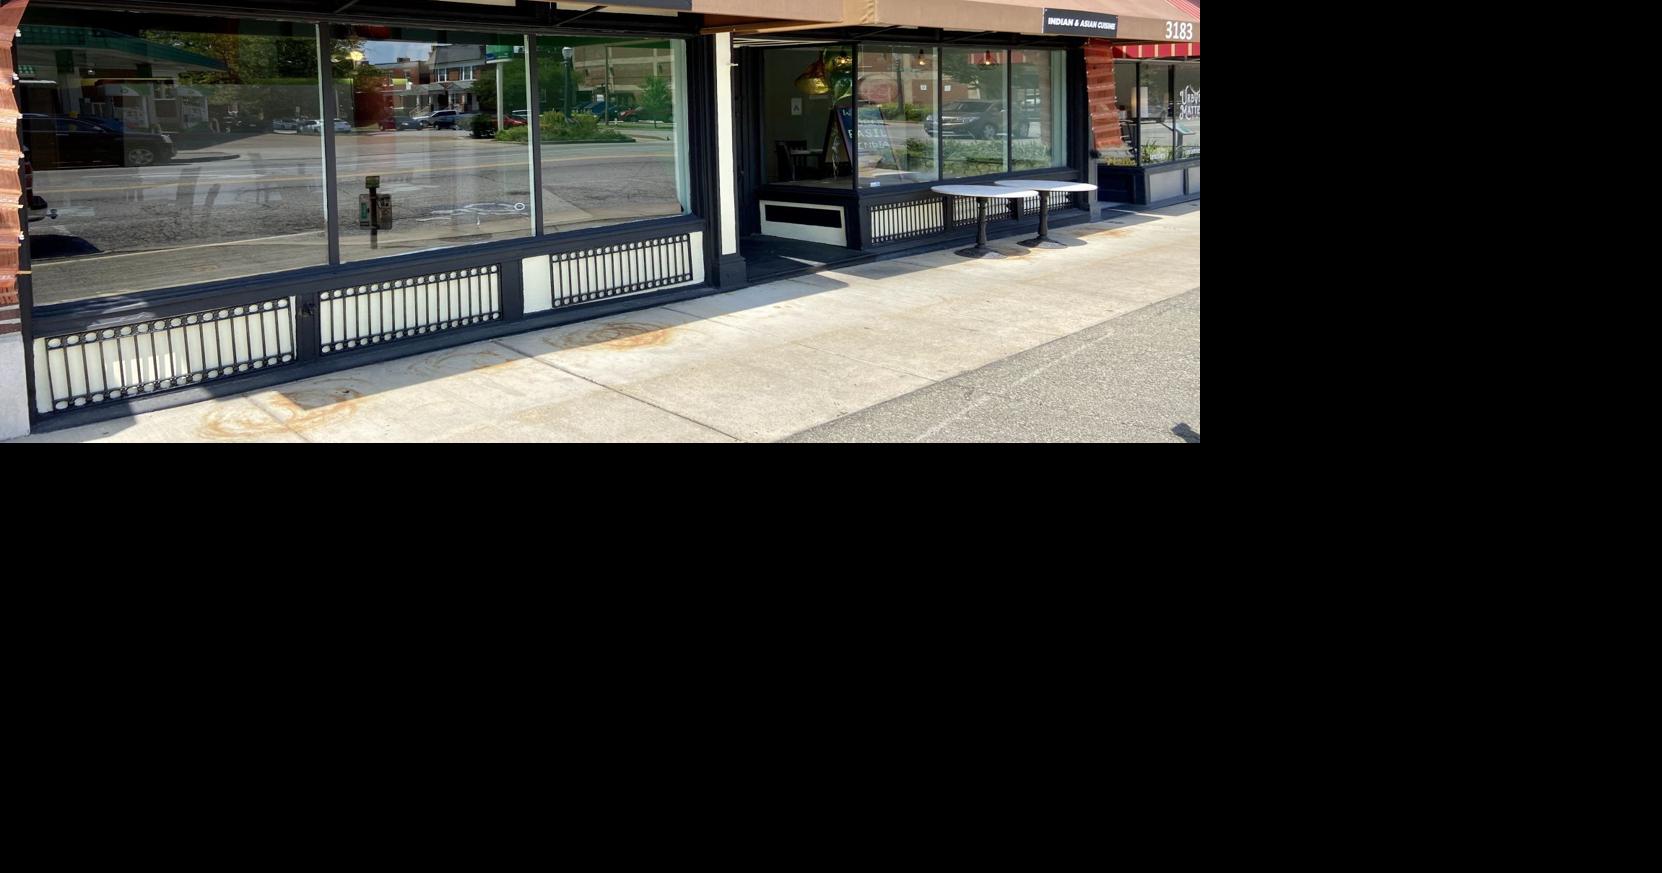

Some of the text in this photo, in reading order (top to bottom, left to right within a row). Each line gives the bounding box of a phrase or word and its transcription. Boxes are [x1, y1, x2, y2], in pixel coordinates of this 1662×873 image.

[1047, 17, 1116, 30] INDIAN & ASIAN CUISINE
[1165, 21, 1193, 40] 3183
